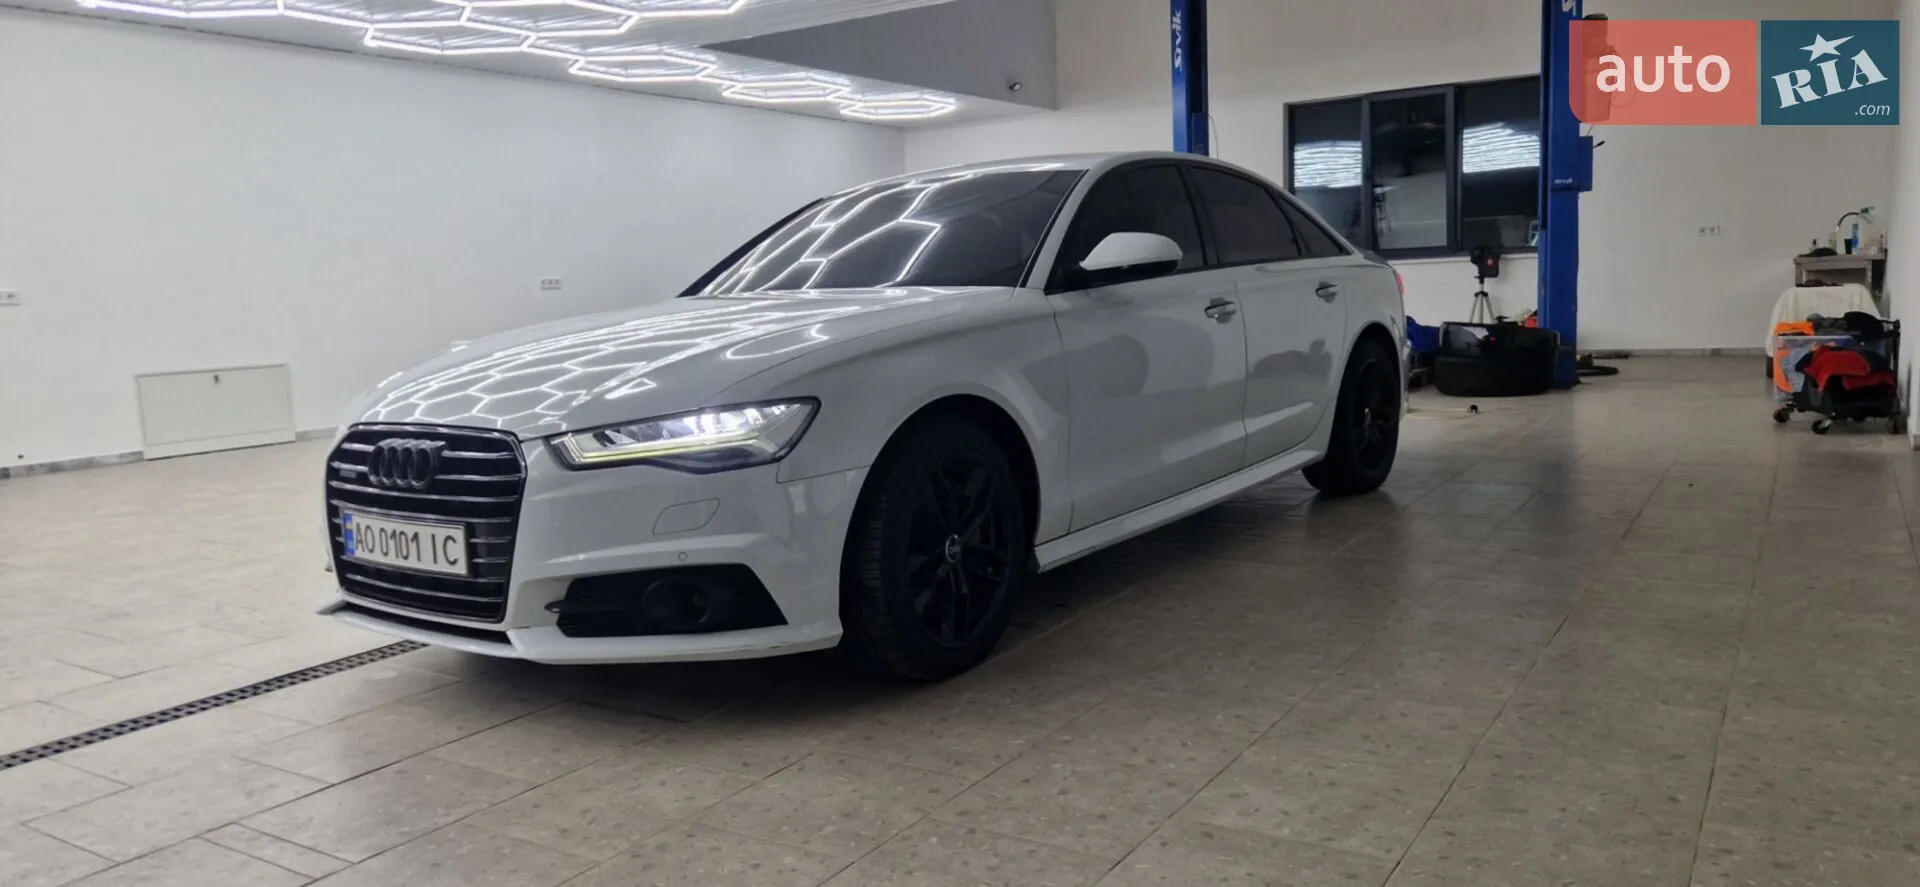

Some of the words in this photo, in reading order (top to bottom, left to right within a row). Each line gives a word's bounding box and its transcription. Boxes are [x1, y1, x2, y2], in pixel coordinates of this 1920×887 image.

[356, 522, 376, 554] AO
[379, 527, 422, 562] 0101
[431, 533, 459, 566] IC
